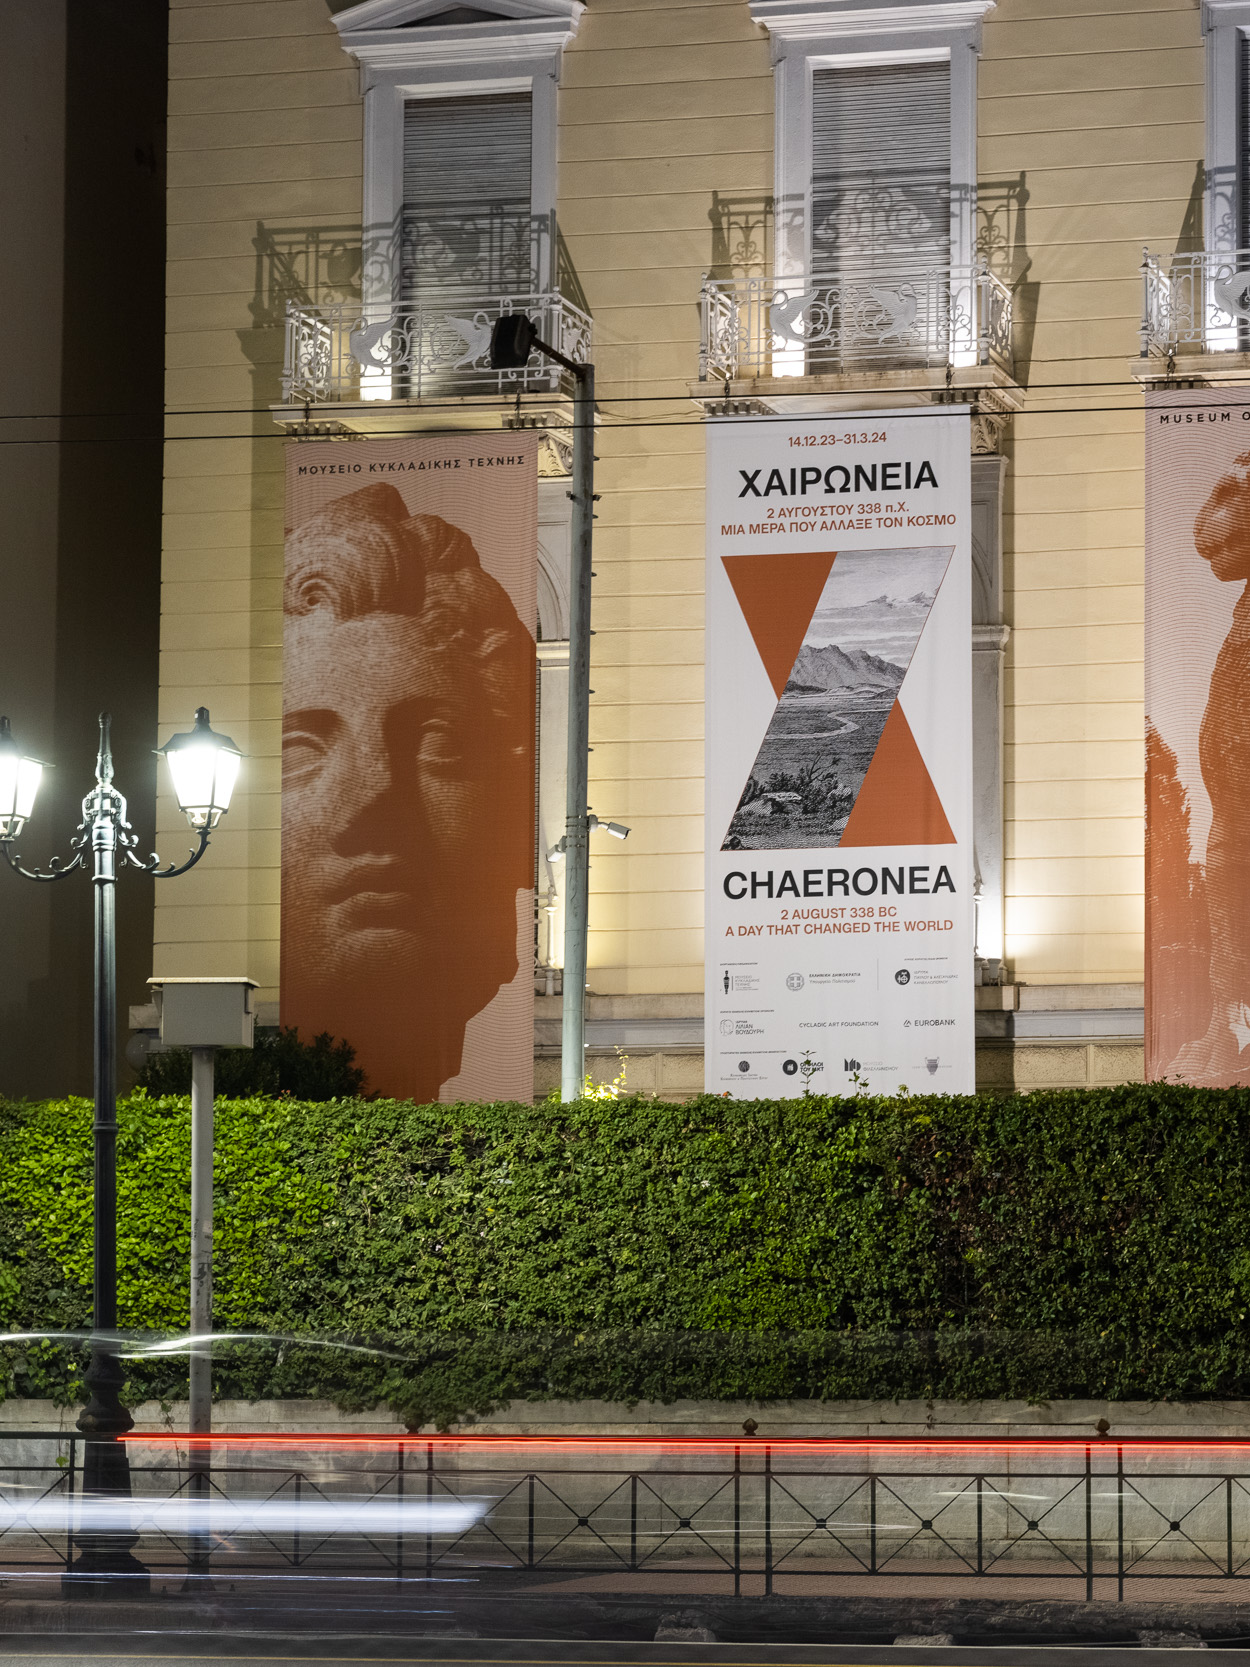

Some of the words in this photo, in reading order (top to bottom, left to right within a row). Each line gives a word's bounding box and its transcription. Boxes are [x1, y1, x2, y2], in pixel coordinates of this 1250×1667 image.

[1160, 412, 1230, 424] MUSEUM
[298, 464, 362, 475] ΜΟΥΣΕΙΟ
[369, 459, 461, 472] ΚΥΚΛΑΔΙΚΗΣ
[468, 456, 525, 467] ΤΕΧΝΗΣ
[738, 460, 938, 498] ΧΑΙΡΩΝΕΙΑ
[767, 508, 774, 519] 2
[778, 504, 854, 518] ΑΥΓΟΥΣΤΟΥ
[857, 503, 882, 515] 338
[721, 524, 745, 536] ΜΙΑ
[749, 522, 786, 534] ΜΕΡΑ
[790, 521, 816, 533] ΠΟΥ
[820, 518, 872, 532] ΑΛΛΑΞΕ
[876, 516, 902, 529] ΤΟΝ
[908, 514, 956, 527] ΚΟΣΜΟ
[723, 865, 956, 900] CHAERONEA
[780, 909, 788, 920] 2
[792, 908, 846, 920] AUGUST
[850, 906, 875, 918] 338
[878, 906, 897, 918] BC
[725, 926, 734, 936] A
[738, 925, 764, 936] DAY
[767, 924, 800, 936] THAT
[804, 922, 870, 935] CHANGED
[874, 921, 900, 932] THE
[904, 920, 953, 931] WORLD
[914, 1019, 955, 1027] EUROBANK
